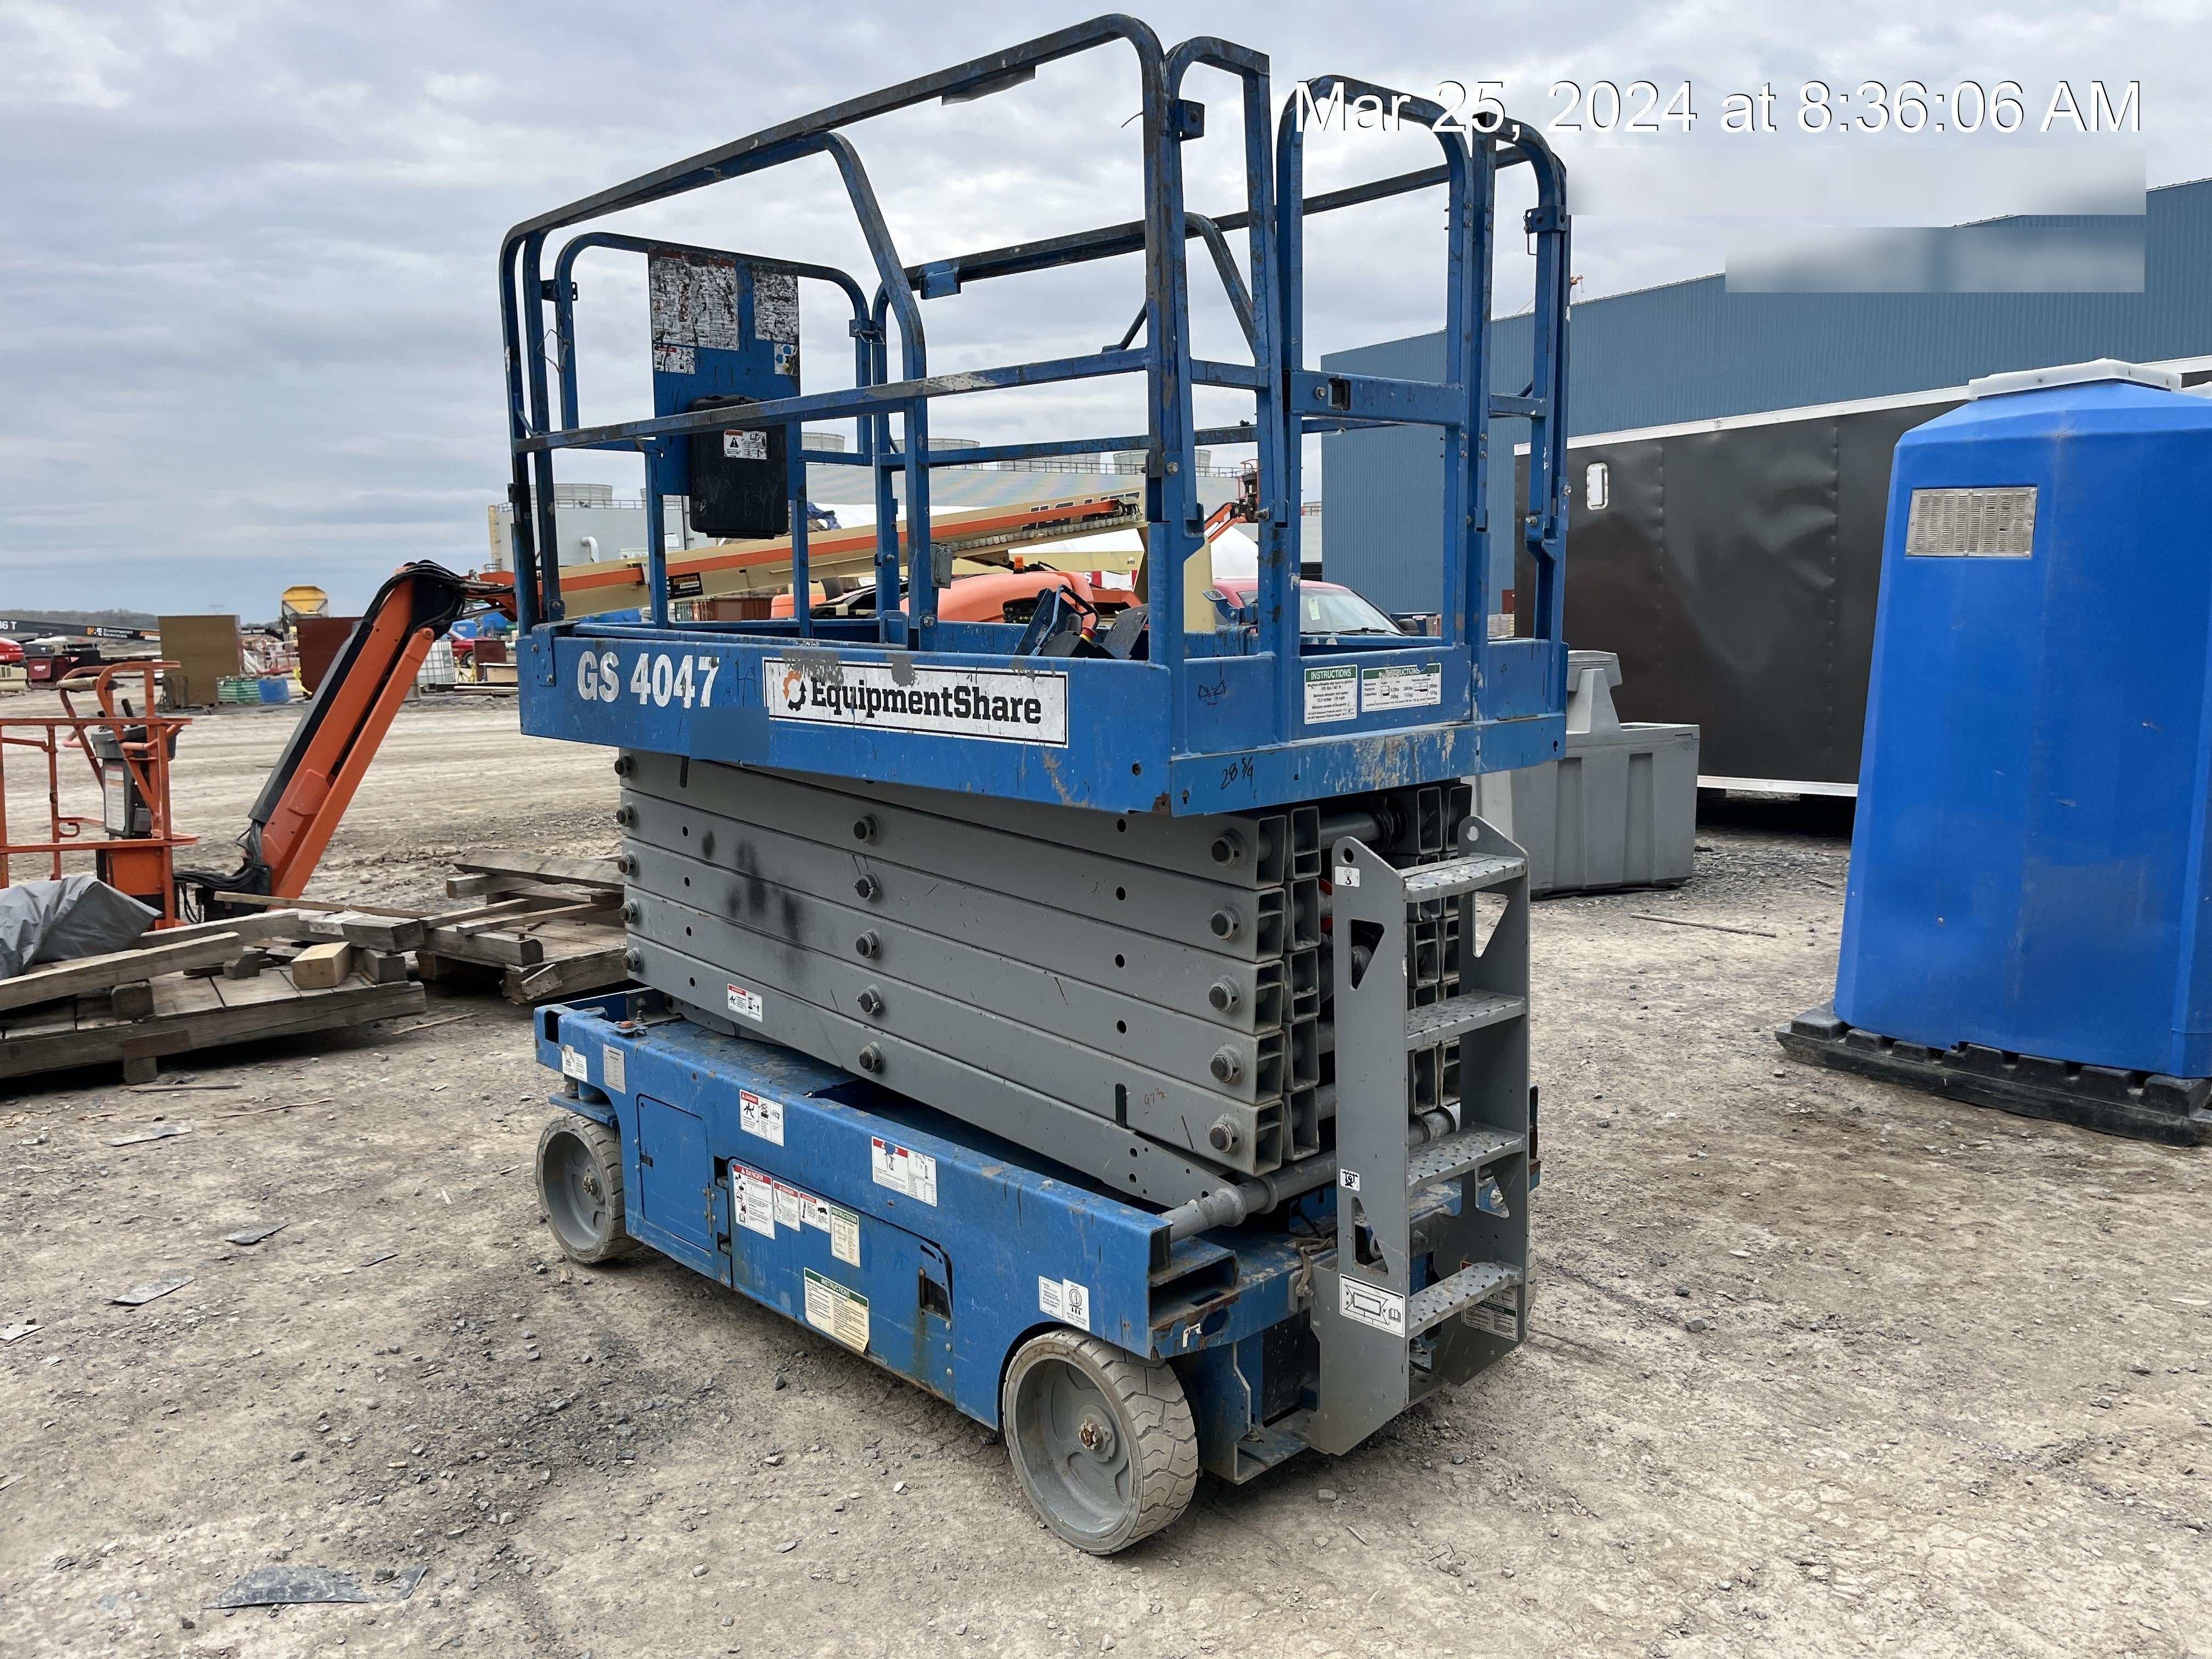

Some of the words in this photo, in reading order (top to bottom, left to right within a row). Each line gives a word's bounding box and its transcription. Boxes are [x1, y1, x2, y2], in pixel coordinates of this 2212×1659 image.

[577, 651, 619, 703] GS
[630, 653, 720, 709] 4047
[1311, 668, 1352, 680] INSTRUCTIONS
[811, 678, 1041, 724] EquipmentShare
[821, 1277, 851, 1299] INSTRUCTIONS
